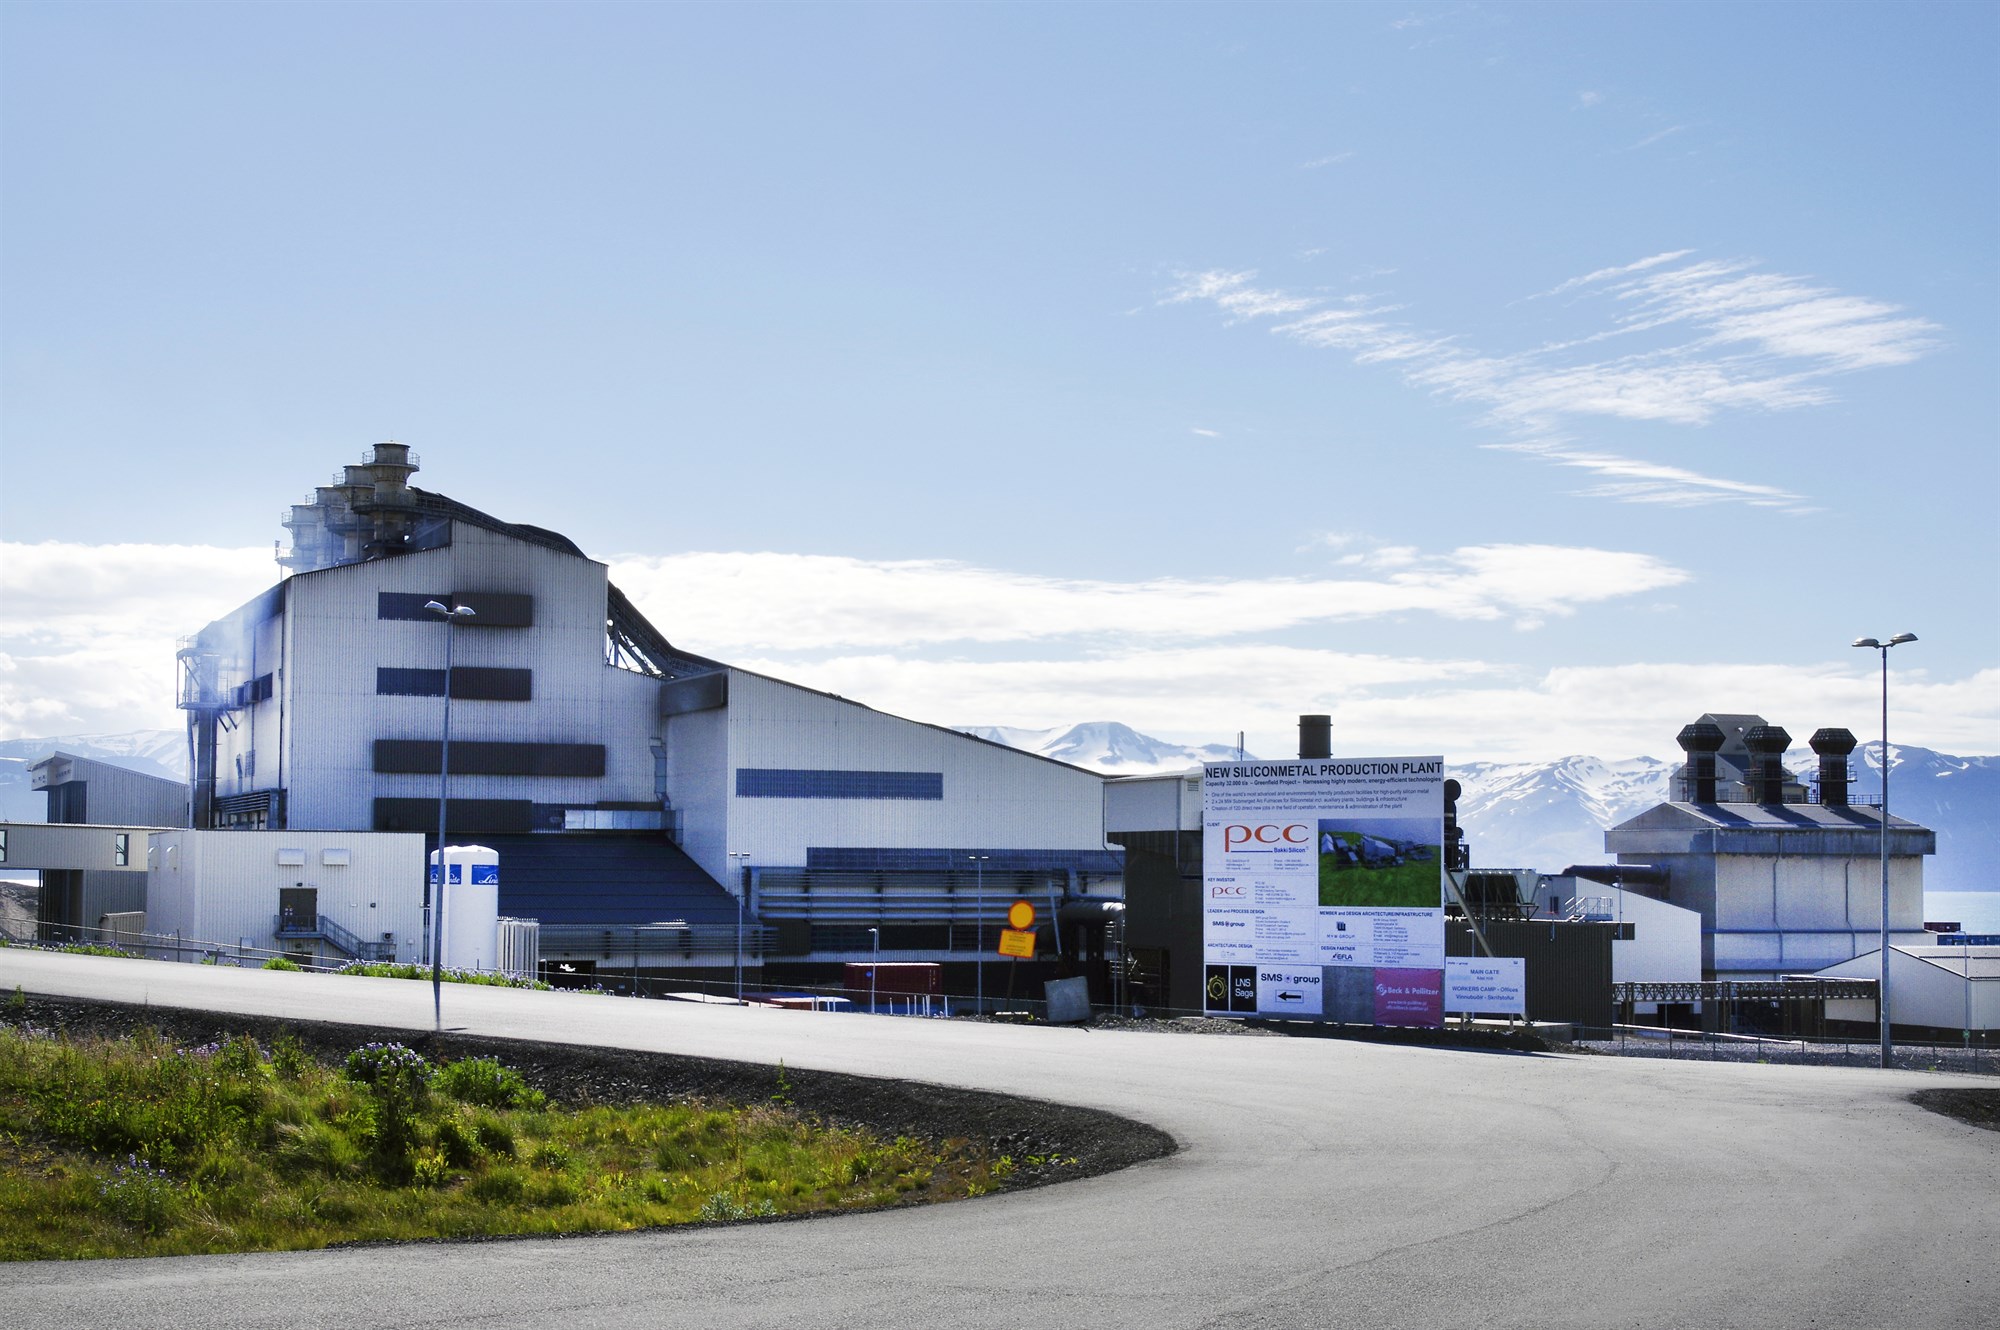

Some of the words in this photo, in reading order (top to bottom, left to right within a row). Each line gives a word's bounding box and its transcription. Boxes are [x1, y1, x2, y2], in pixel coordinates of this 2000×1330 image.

[1205, 767, 1230, 778] NEW
[1233, 765, 1316, 778] SILICONMETAL
[1320, 763, 1398, 776] PRODUCTION
[1402, 762, 1442, 774] PLANT
[1235, 978, 1250, 987] LNS
[1261, 973, 1282, 982] SMS
[1293, 976, 1320, 984] group
[1235, 989, 1254, 998] Saga
